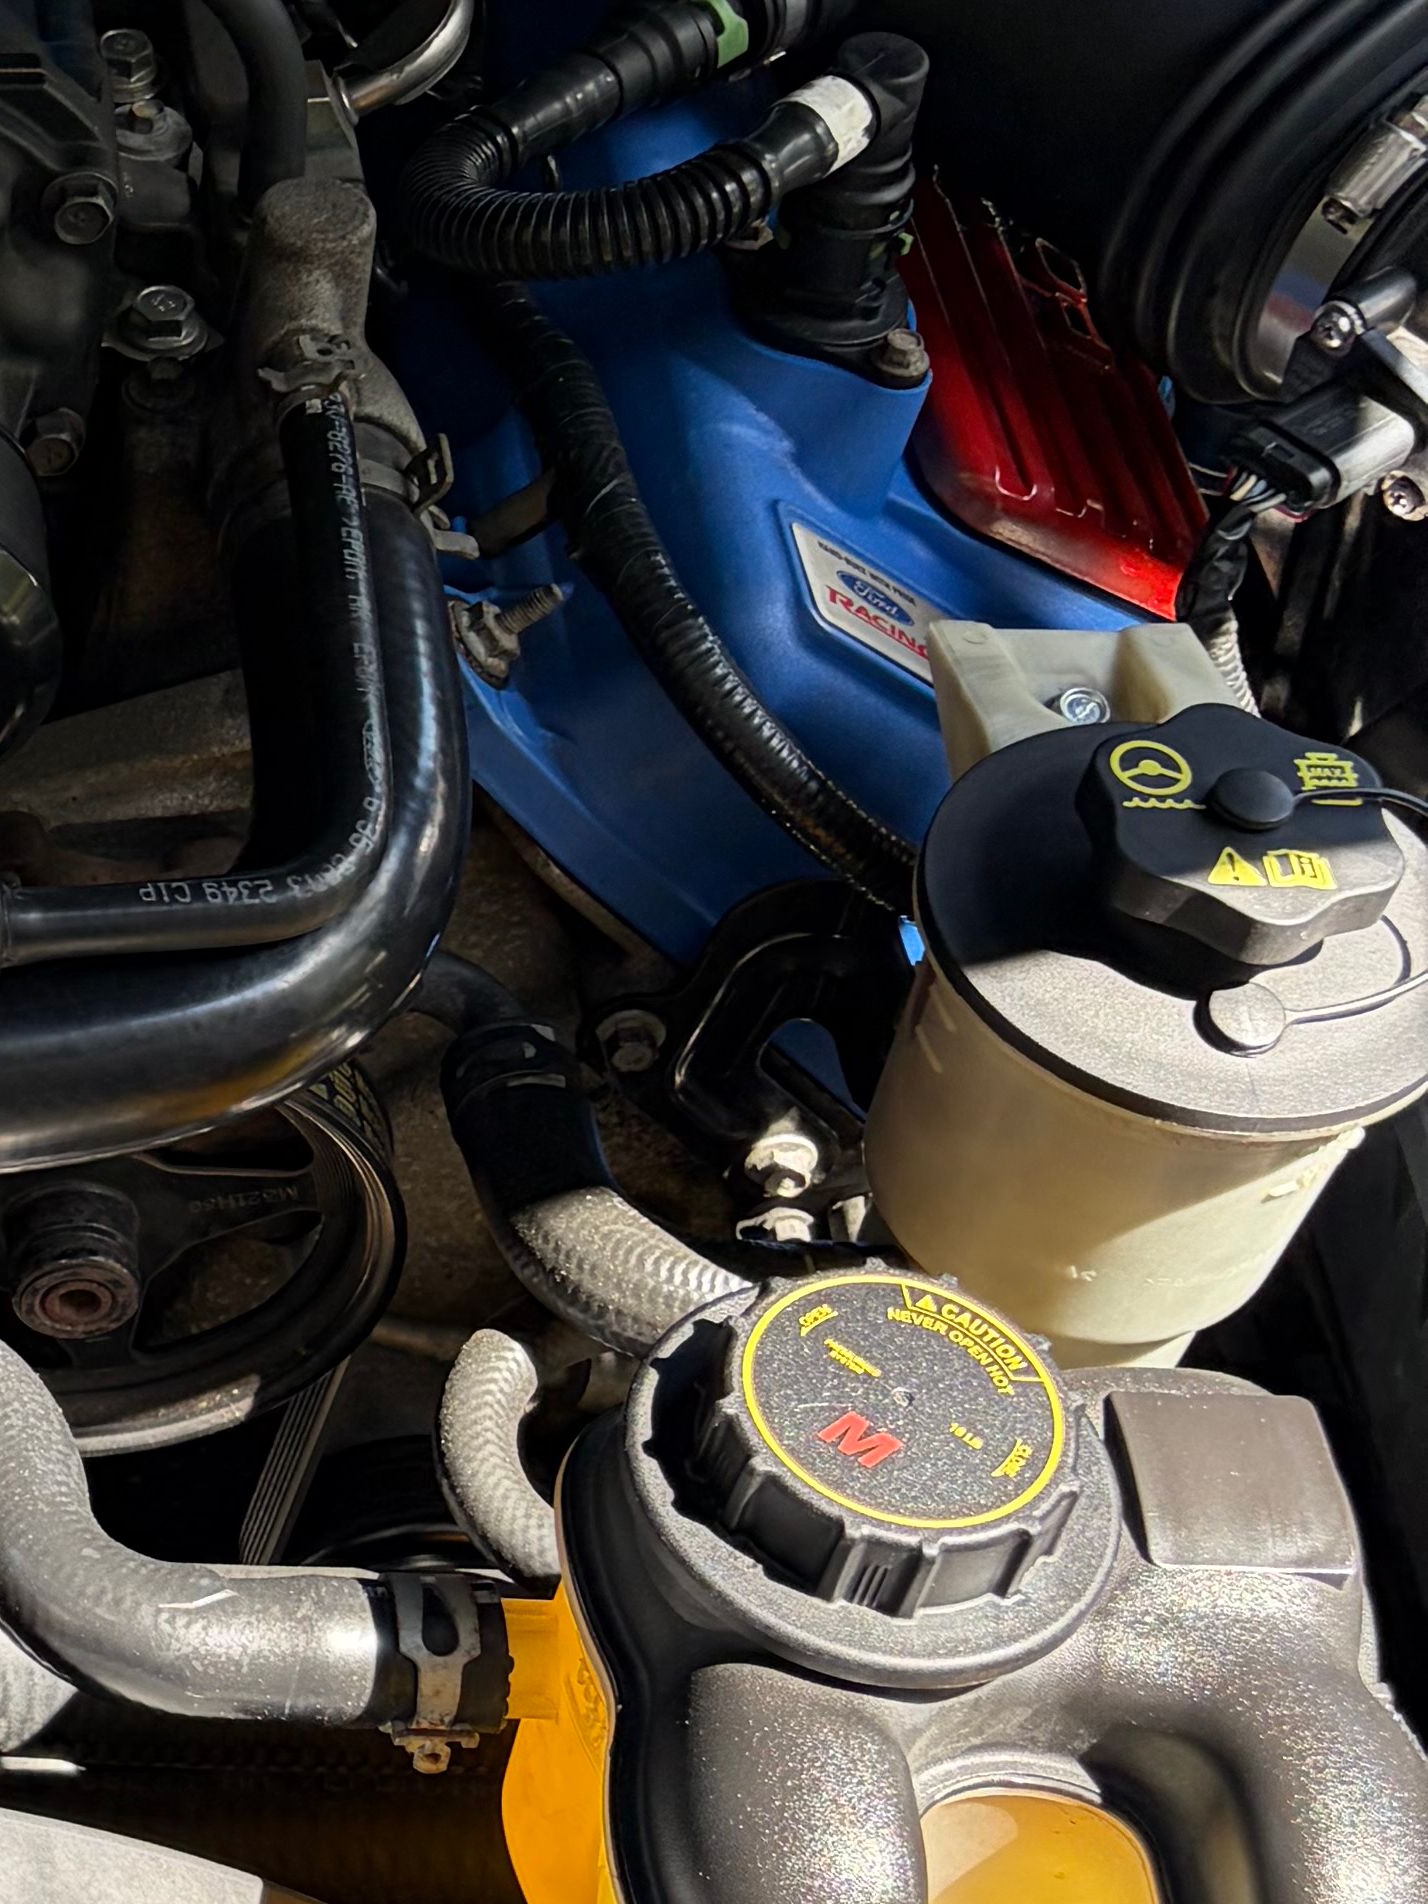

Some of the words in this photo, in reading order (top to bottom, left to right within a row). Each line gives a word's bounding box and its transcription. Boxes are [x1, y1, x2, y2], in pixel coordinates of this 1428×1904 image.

[853, 580, 899, 618] Ford
[887, 1307, 947, 1336] NEVER
[948, 1329, 992, 1366] OPEN
[986, 1364, 1016, 1397] HOT
[941, 1304, 1028, 1371] CAUTION
